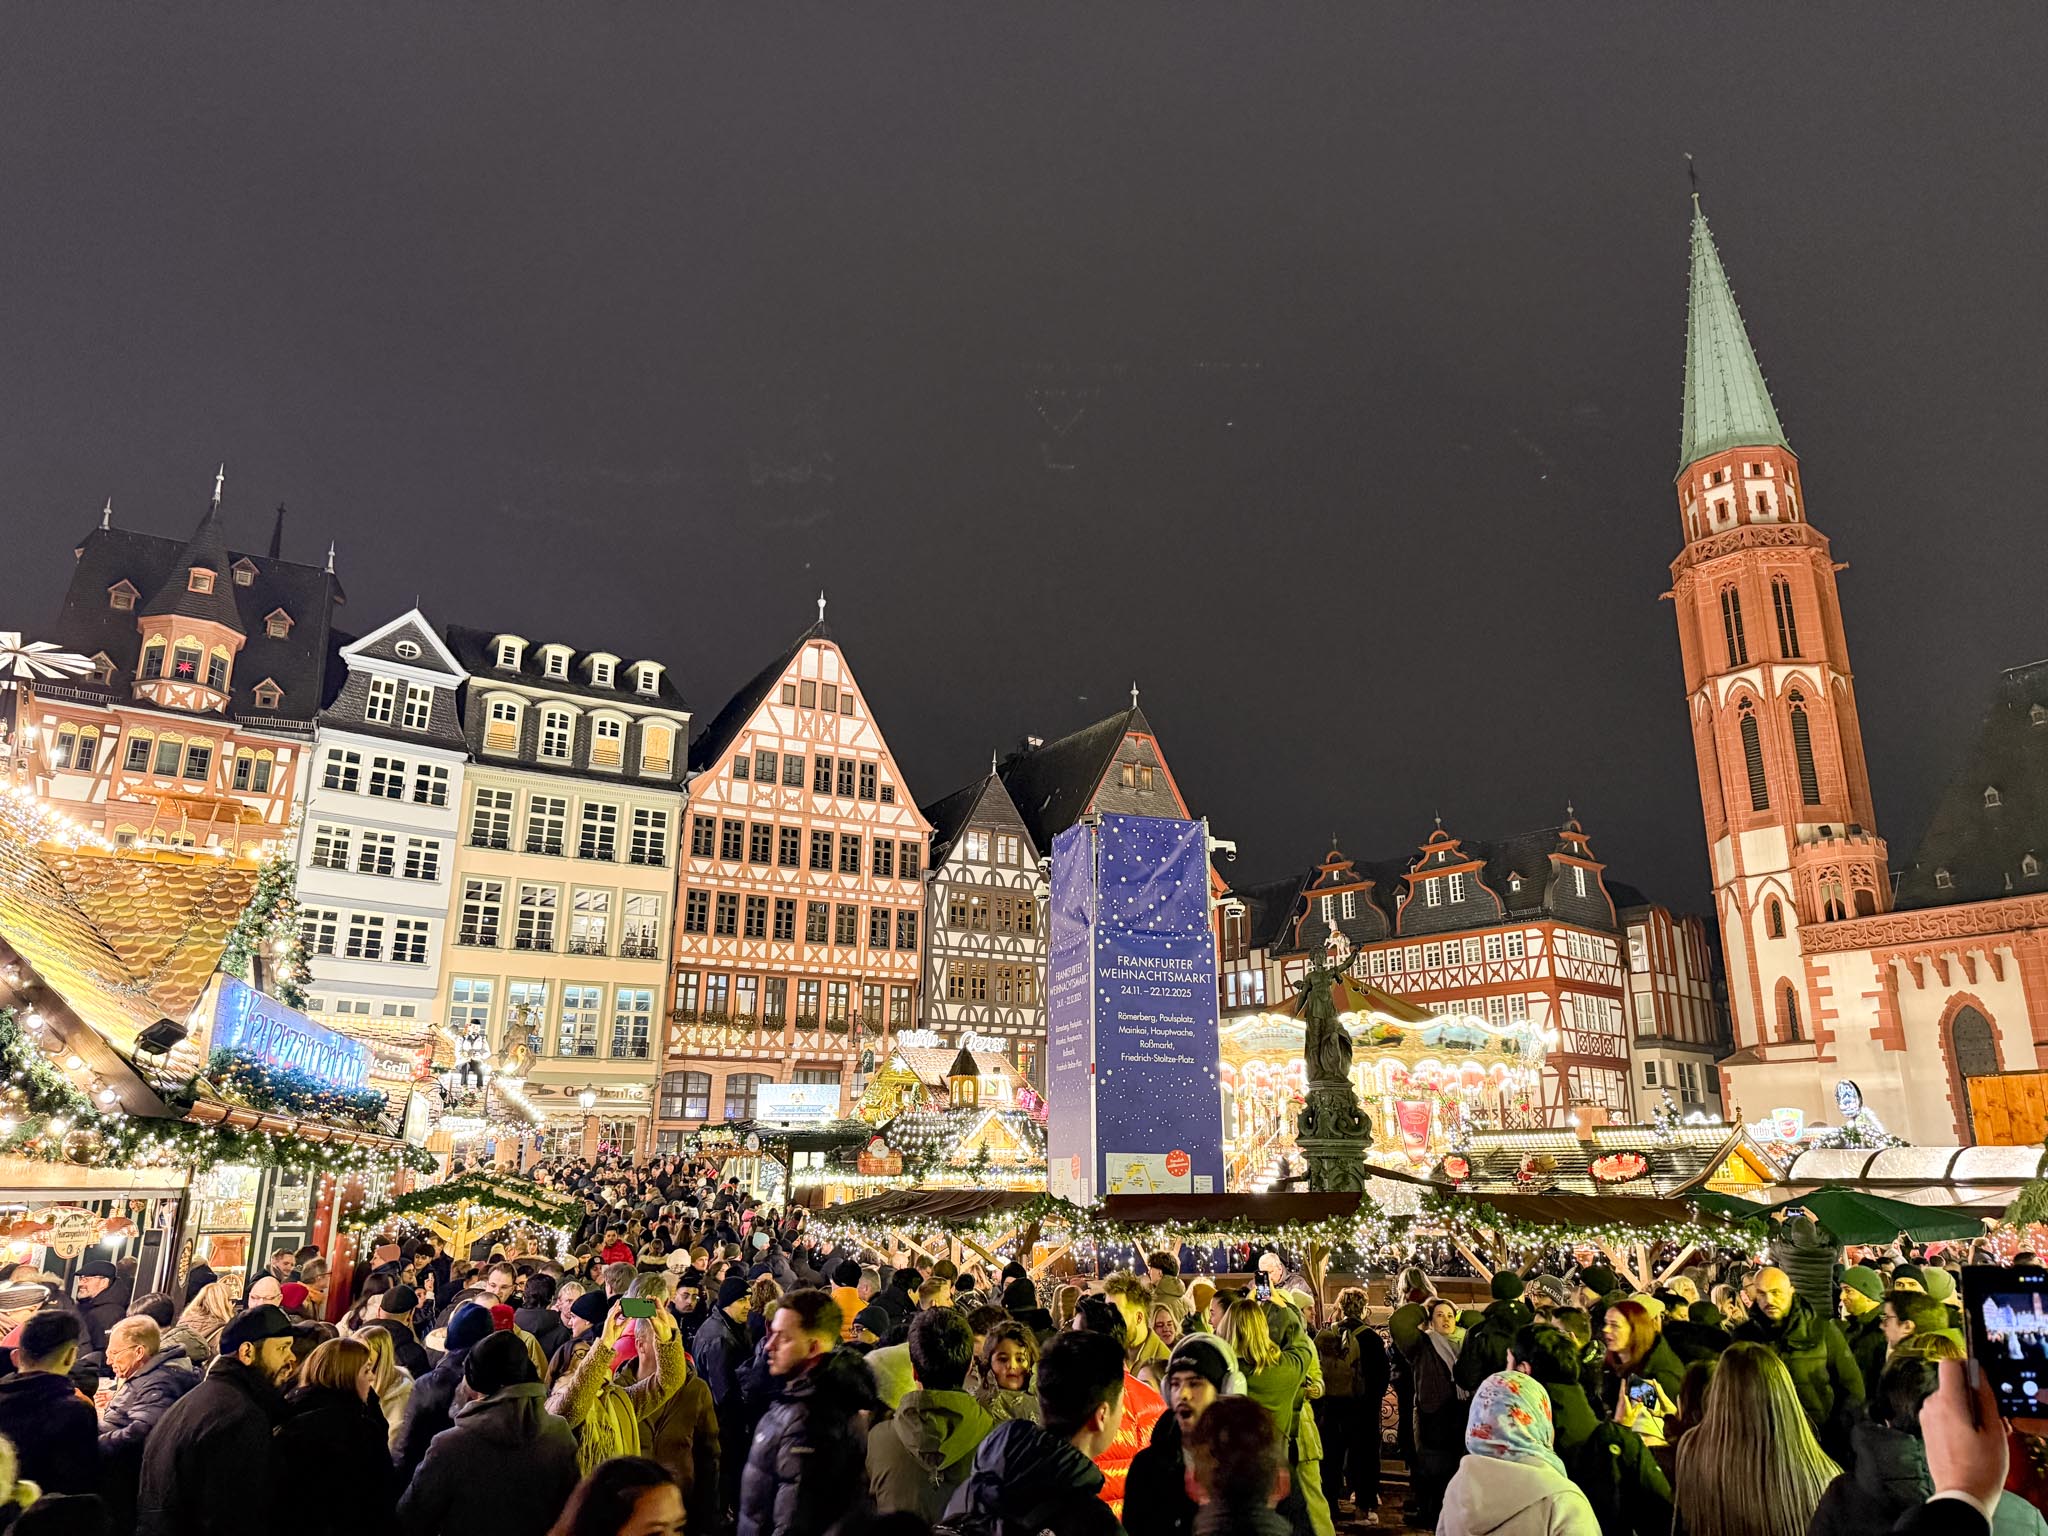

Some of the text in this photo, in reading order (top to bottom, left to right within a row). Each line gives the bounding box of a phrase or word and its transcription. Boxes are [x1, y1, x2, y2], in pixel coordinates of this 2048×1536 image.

[1117, 955, 1193, 970] FRANKFURTER
[1099, 967, 1212, 984] WEIHNACHTSMARKT
[1120, 985, 1142, 995] 24.11.
[1150, 987, 1192, 998] 22.12.2025
[1117, 1011, 1195, 1025] Römerberg, Paulsplatz,
[1118, 1026, 1195, 1038] Mainkai, Hauptwache,
[1139, 1039, 1175, 1050] Roßmarkt,
[1121, 1052, 1195, 1064] Friedrich-Stoltze-Platz
[563, 1085, 644, 1100] Gehenke
